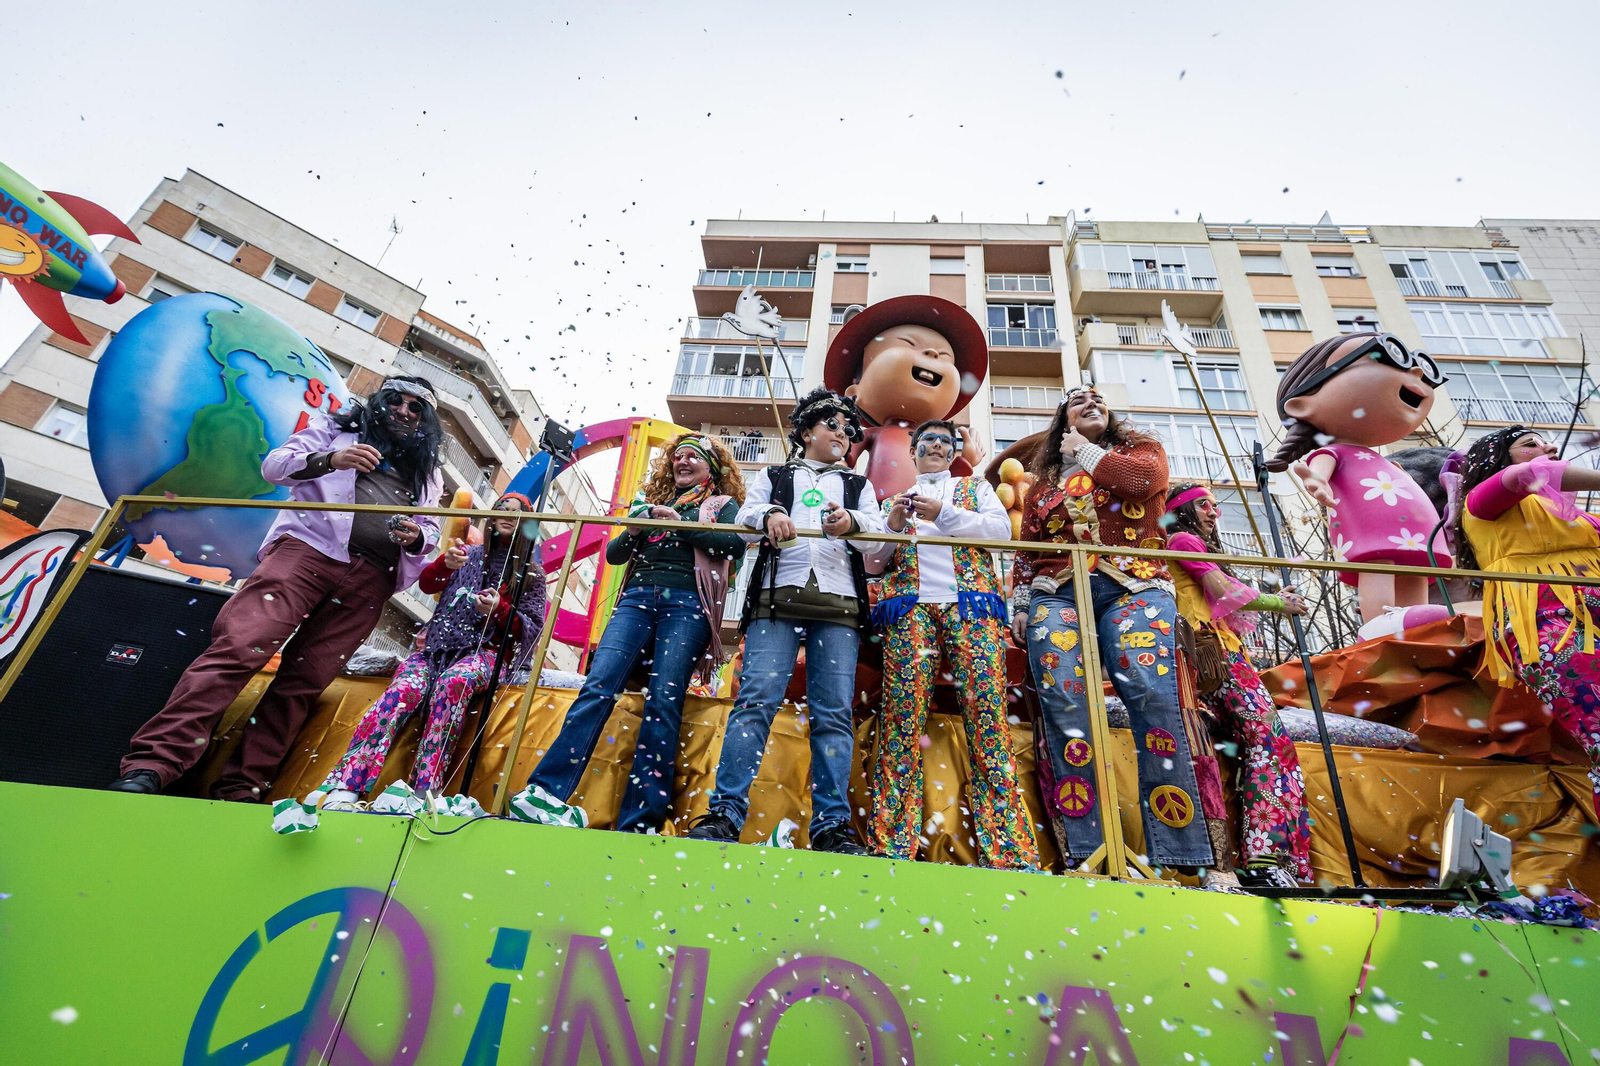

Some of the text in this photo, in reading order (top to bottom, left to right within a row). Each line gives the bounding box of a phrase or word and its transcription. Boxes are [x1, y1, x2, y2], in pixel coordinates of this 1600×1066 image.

[39, 224, 88, 271] WAR
[1120, 631, 1156, 651] PAZ
[110, 650, 139, 660] DAS
[1063, 679, 1087, 697] PA
[1145, 732, 1176, 752] PAZ
